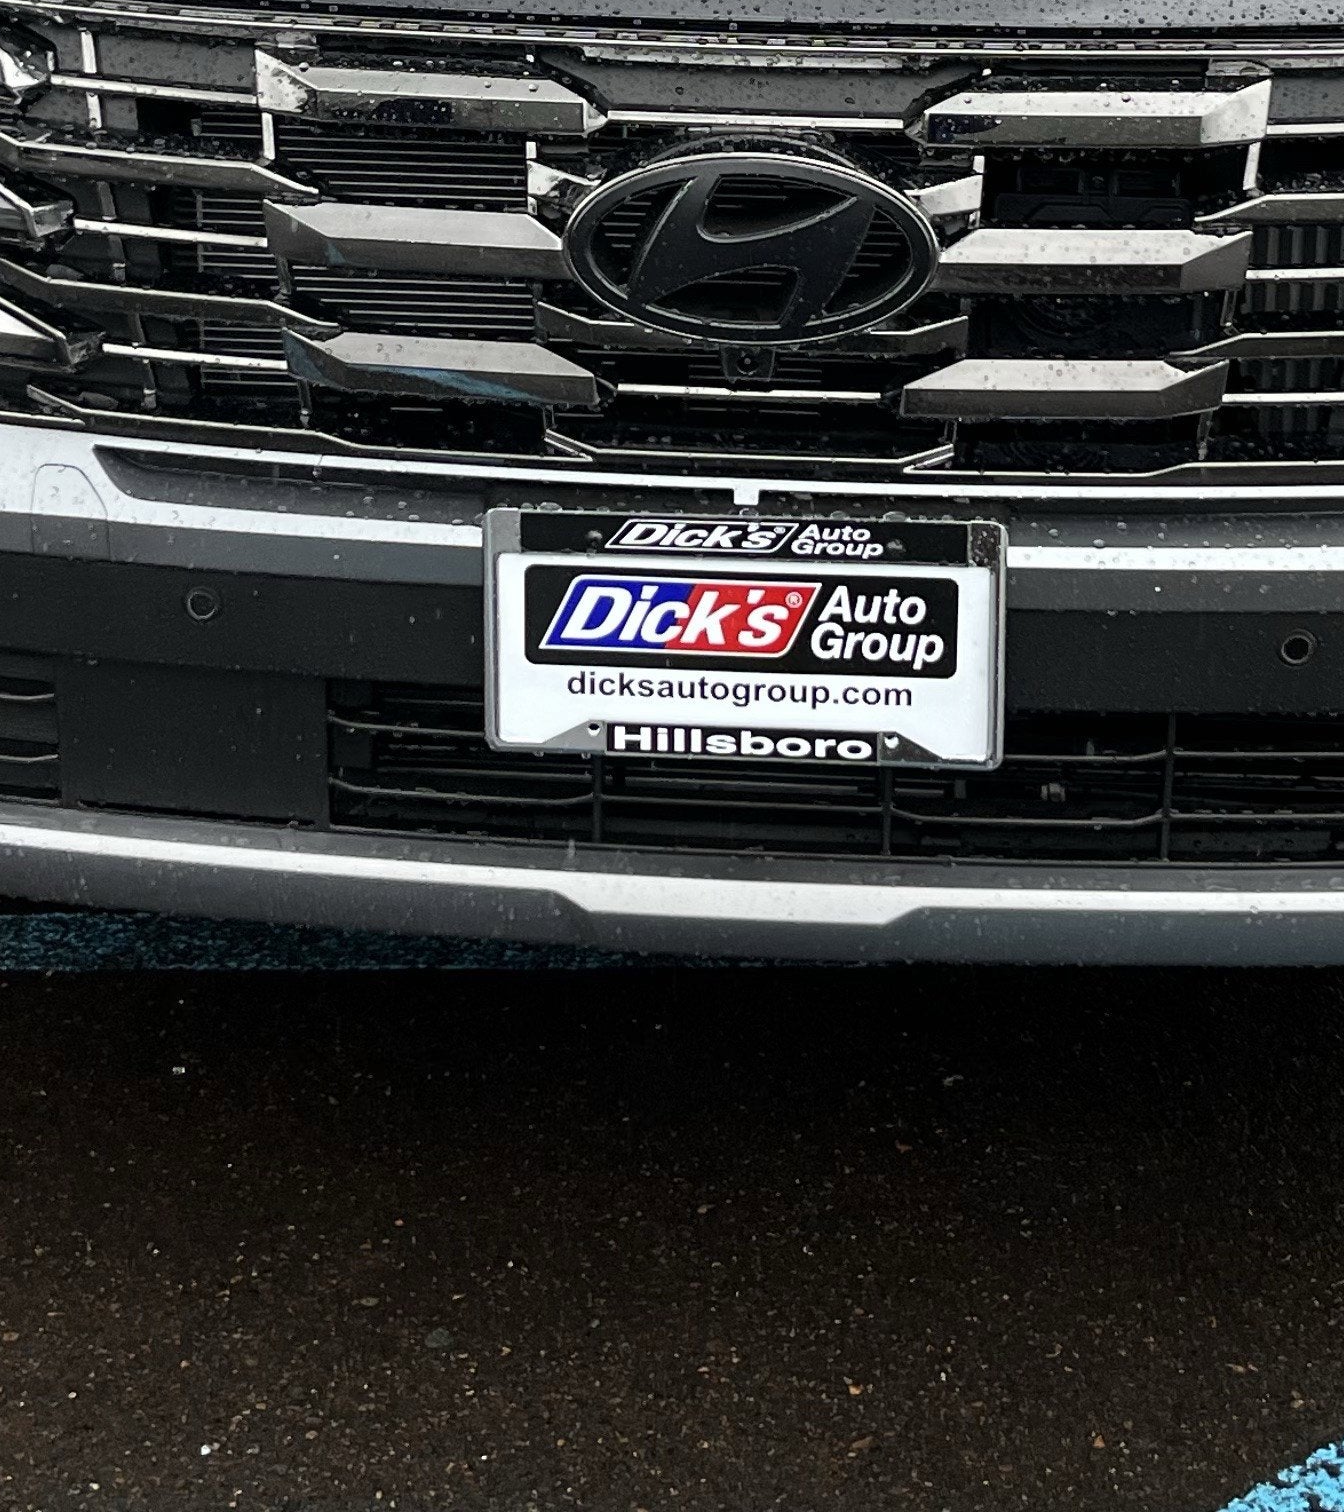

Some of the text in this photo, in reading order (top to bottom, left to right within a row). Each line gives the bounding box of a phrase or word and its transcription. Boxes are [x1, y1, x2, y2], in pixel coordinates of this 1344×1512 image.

[618, 521, 871, 549] Dick's Auto
[790, 539, 884, 559] Group
[561, 585, 927, 648] Dick's Auto
[811, 622, 945, 671] Group
[567, 671, 913, 710] dicksautogroup.com
[613, 725, 873, 760] Hillsboro
